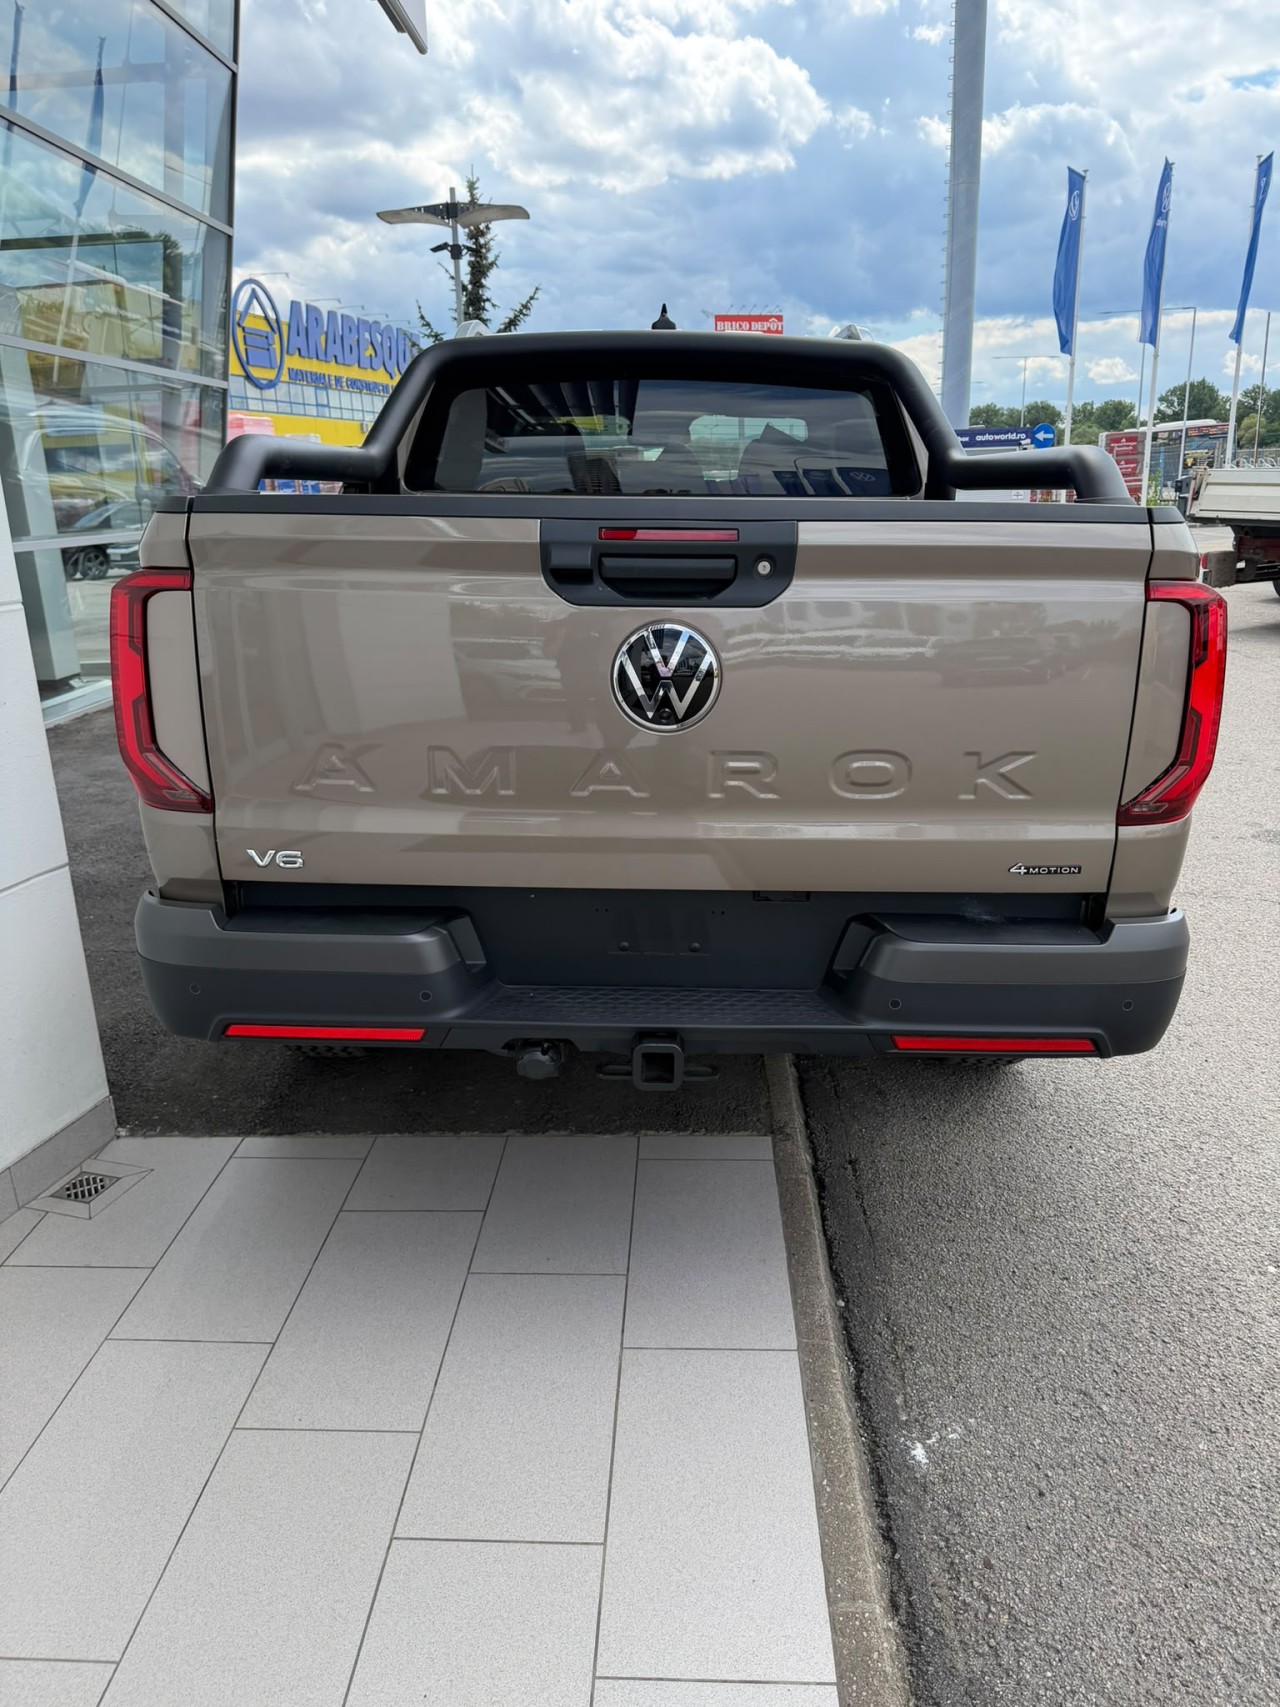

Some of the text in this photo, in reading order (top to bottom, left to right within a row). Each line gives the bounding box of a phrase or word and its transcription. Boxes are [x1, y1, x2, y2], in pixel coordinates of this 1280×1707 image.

[716, 318, 783, 331] BRICO DEPÔT
[975, 432, 1027, 441] autoworld.ro
[291, 744, 1038, 800] AMAROK
[246, 849, 304, 869] V6
[1008, 862, 1081, 876] 4MOTION
